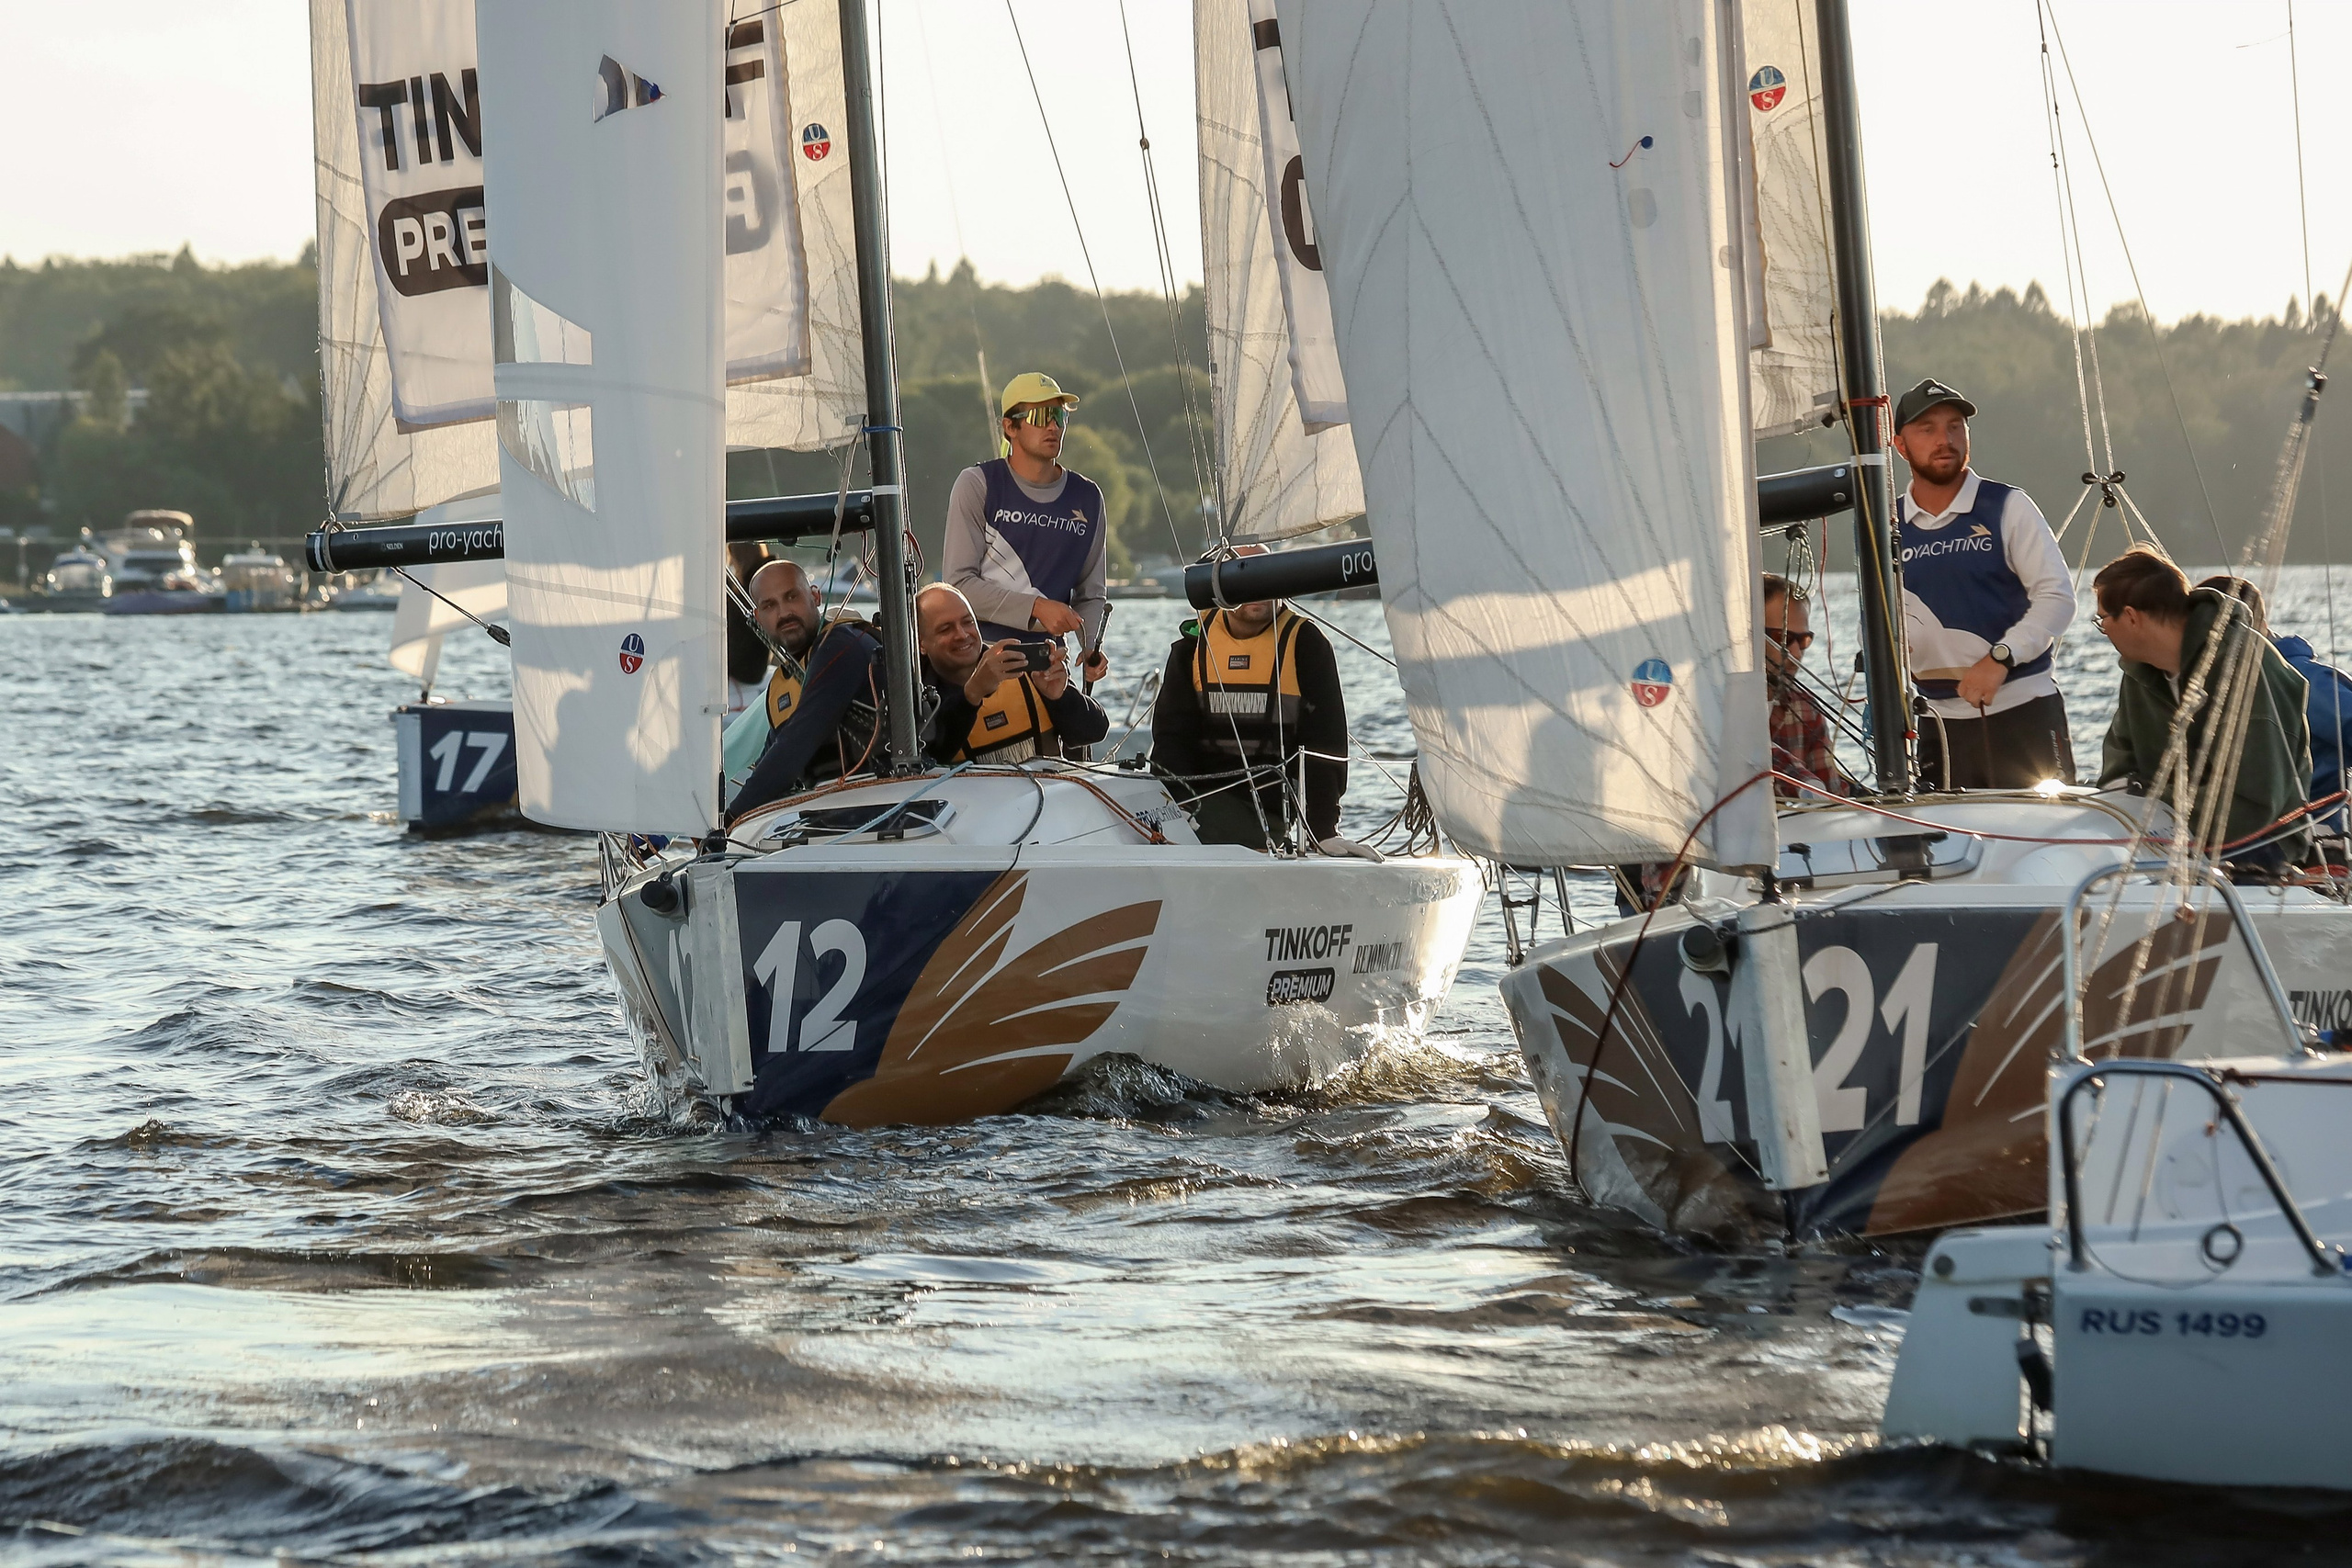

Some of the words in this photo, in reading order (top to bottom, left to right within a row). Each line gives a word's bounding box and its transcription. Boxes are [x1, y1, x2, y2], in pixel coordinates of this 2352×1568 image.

[994, 509, 1087, 536] PROYACHTING
[1341, 551, 1375, 581] pro
[429, 729, 509, 793] 17
[1265, 924, 1353, 961] TINKOFF
[752, 919, 867, 1053] 12
[1271, 974, 1332, 1000] PREMIUM
[1802, 942, 1939, 1133] 21
[2080, 1308, 2161, 1336] RUS
[2176, 1312, 2267, 1339] 1499
